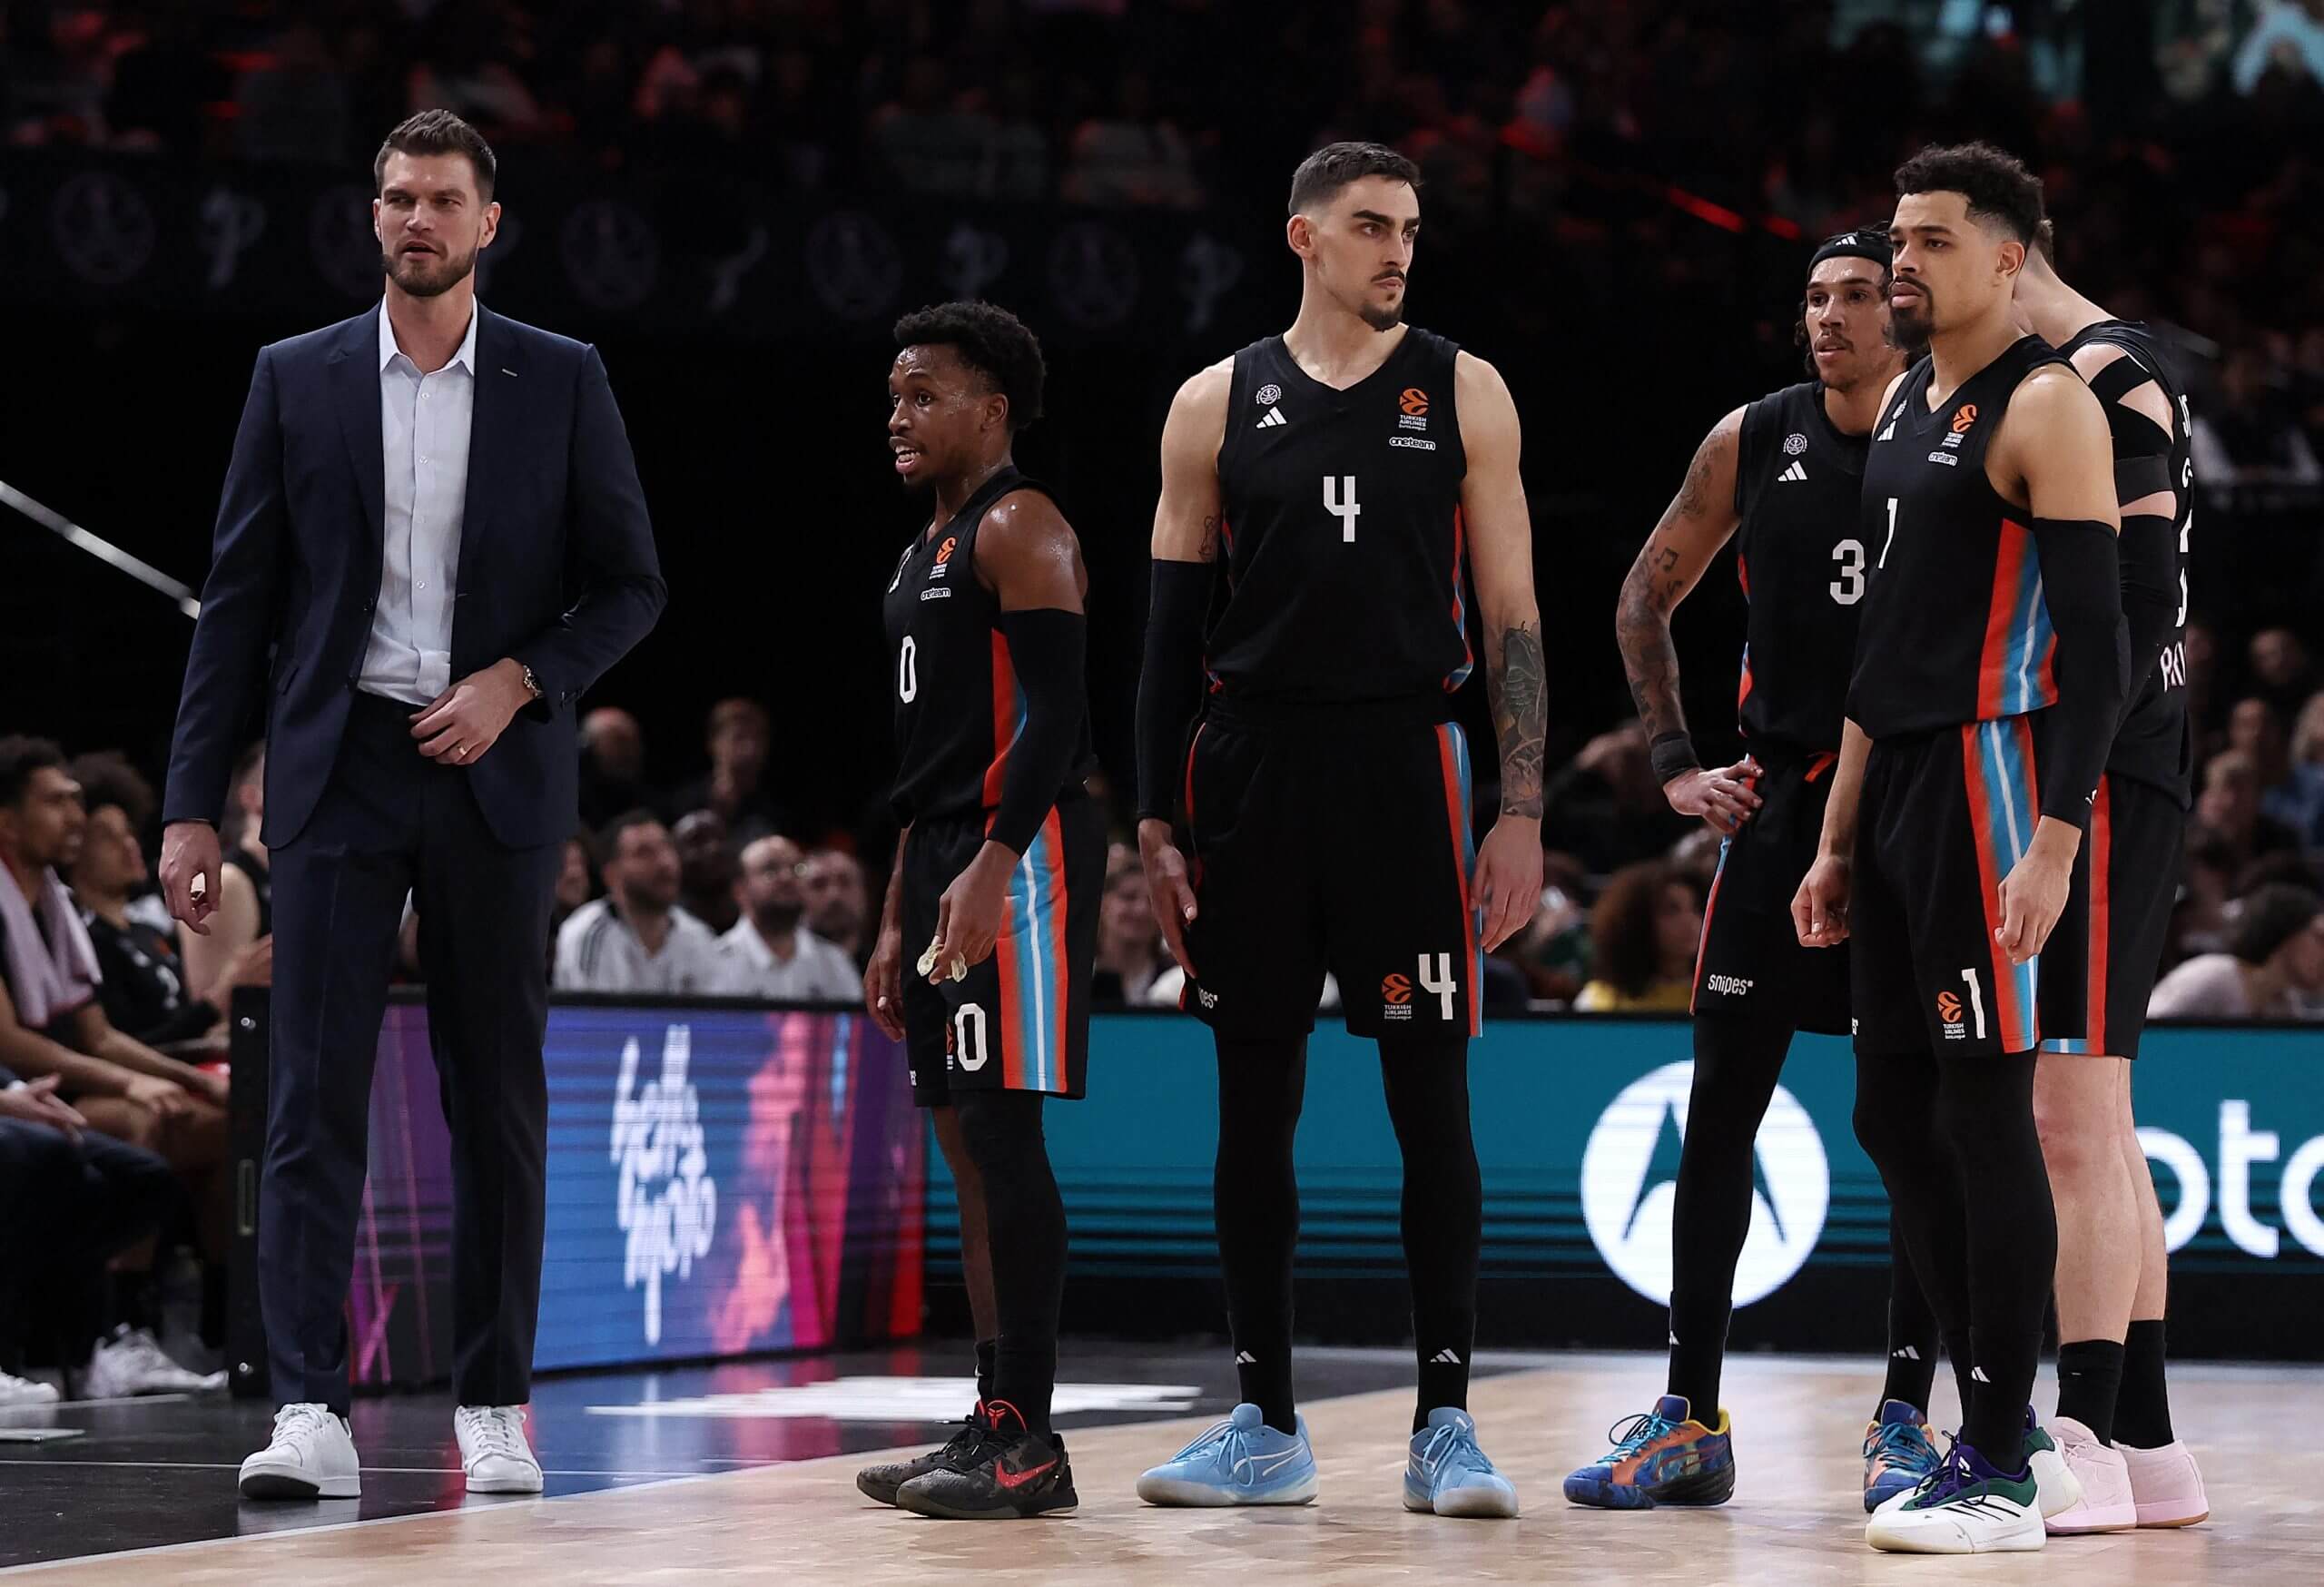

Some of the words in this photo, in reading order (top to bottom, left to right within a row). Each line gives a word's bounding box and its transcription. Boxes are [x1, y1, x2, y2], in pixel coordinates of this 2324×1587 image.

[1324, 476, 1360, 542] 4
[1830, 539, 1866, 605] 3
[900, 636, 916, 704] 0
[1419, 953, 1456, 1020] 4
[1709, 974, 1747, 995] snipes
[1962, 968, 1985, 1040] 1
[955, 1003, 987, 1070] 0
